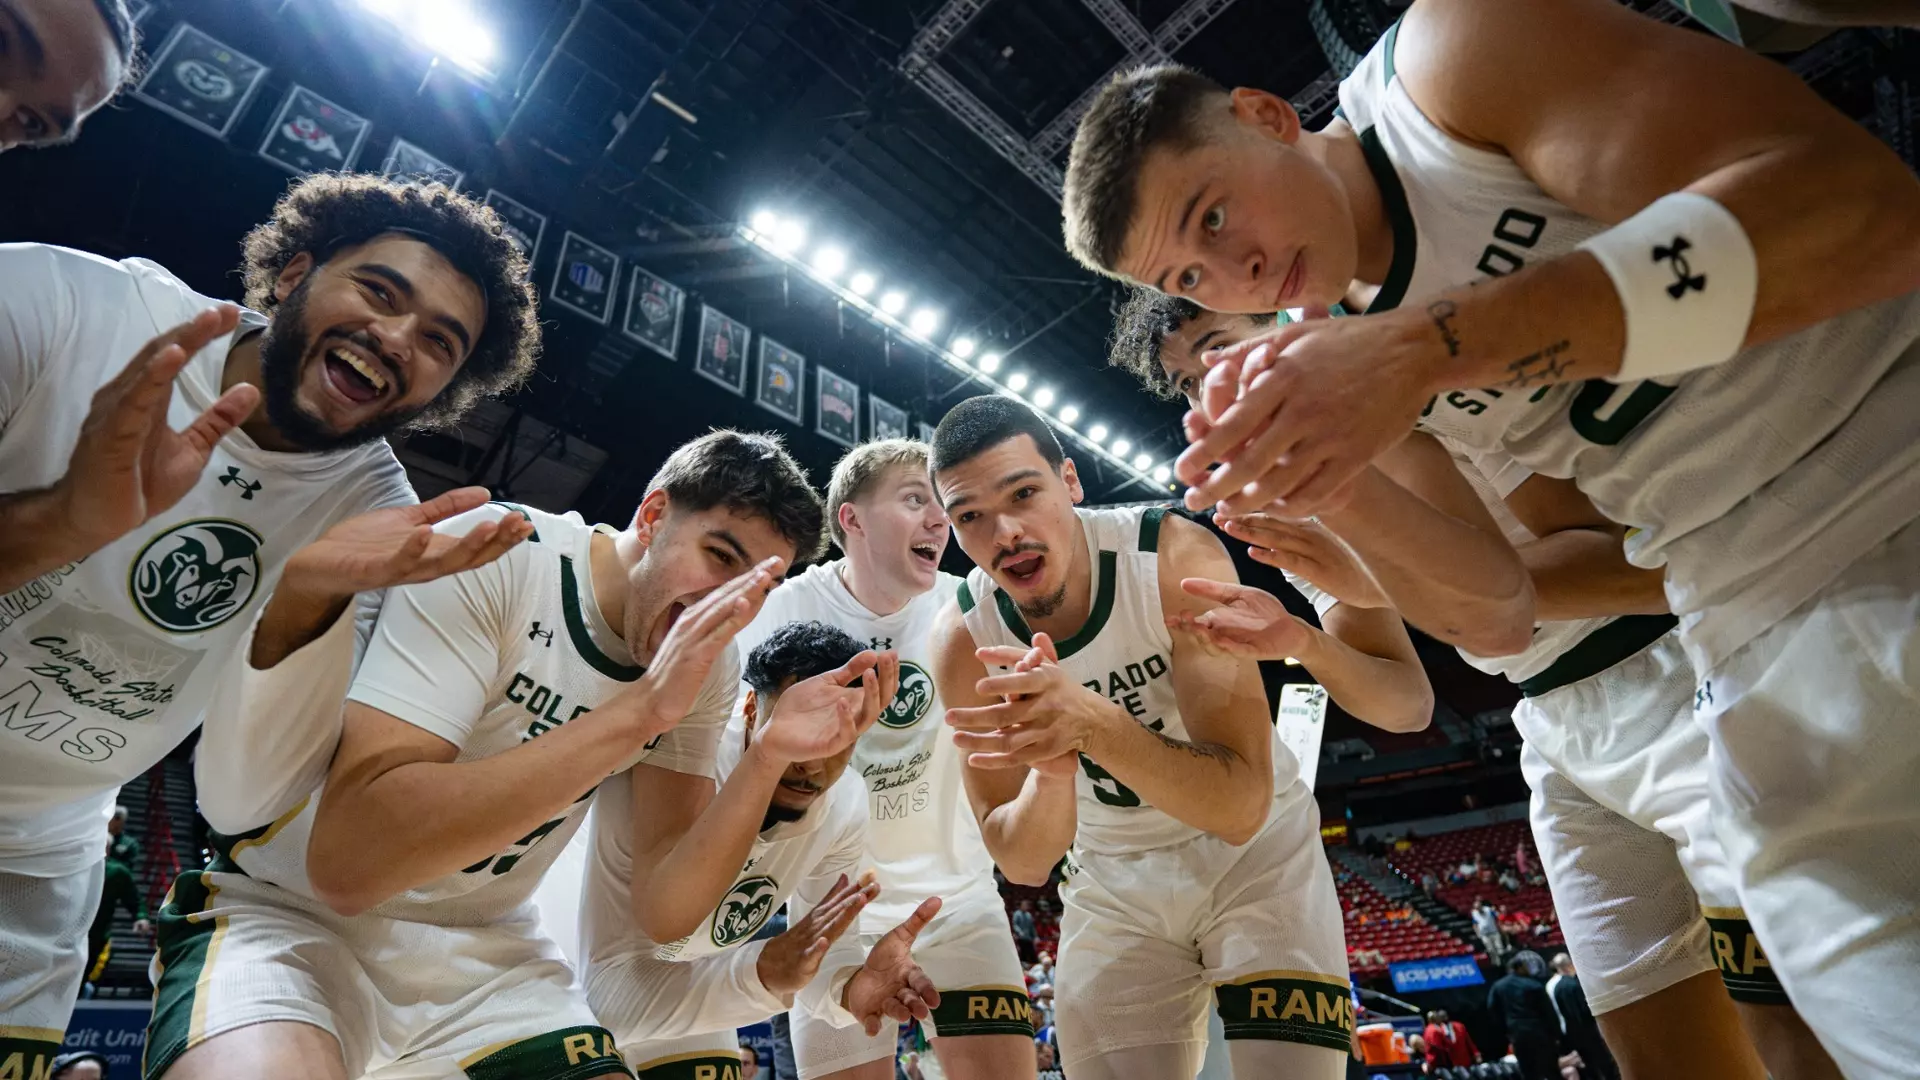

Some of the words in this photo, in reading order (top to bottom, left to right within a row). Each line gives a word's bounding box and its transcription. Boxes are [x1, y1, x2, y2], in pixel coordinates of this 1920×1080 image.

[24, 662, 154, 721] Basketball
[29, 636, 116, 685] Colorado
[103, 681, 175, 704] State
[0, 652, 127, 763] MS
[863, 760, 904, 778] Colorado
[64, 1028, 101, 1047] dit
[104, 1028, 149, 1047] Uni
